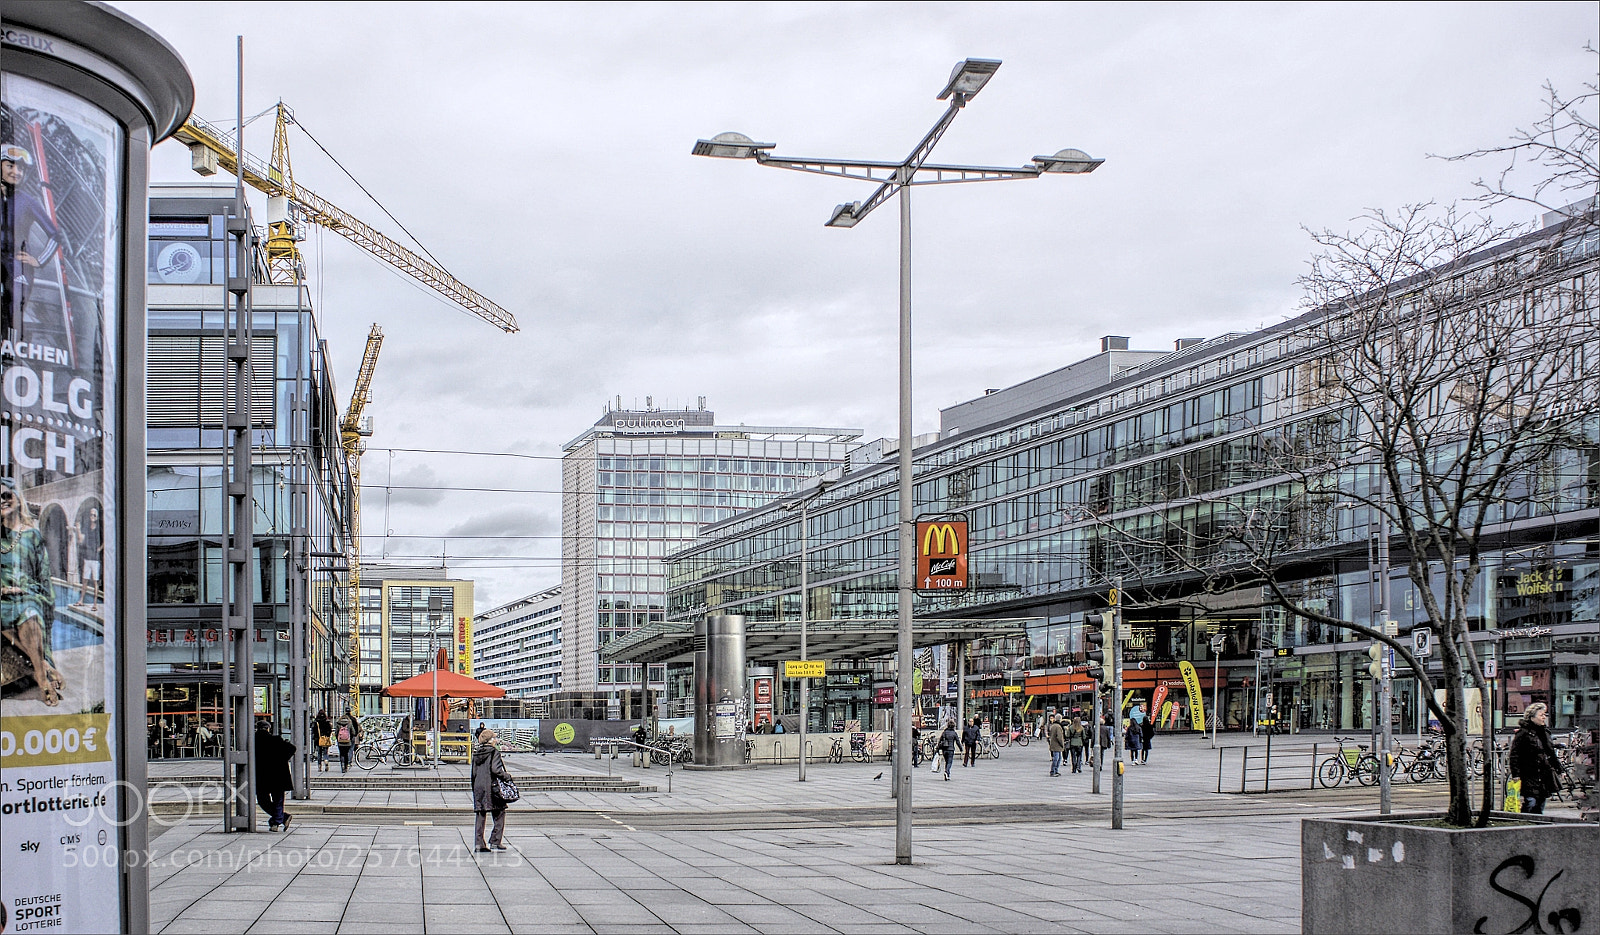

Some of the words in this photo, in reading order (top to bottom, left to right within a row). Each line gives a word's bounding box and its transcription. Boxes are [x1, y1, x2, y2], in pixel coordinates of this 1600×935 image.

[3, 365, 93, 420] OLG
[615, 416, 685, 432] pullman
[936, 579, 952, 587] 100
[1516, 569, 1543, 584] Jack
[1516, 581, 1564, 596] Wolfskn
[205, 629, 268, 642] GRL
[17, 776, 69, 794] Sportler
[71, 773, 107, 787] fördern.
[1, 791, 107, 815] ortlotterie.de
[20, 840, 40, 853] sky
[14, 893, 62, 907] DEUTSCHE
[15, 904, 62, 921] SPORT
[15, 917, 62, 932] LOTTERIE
